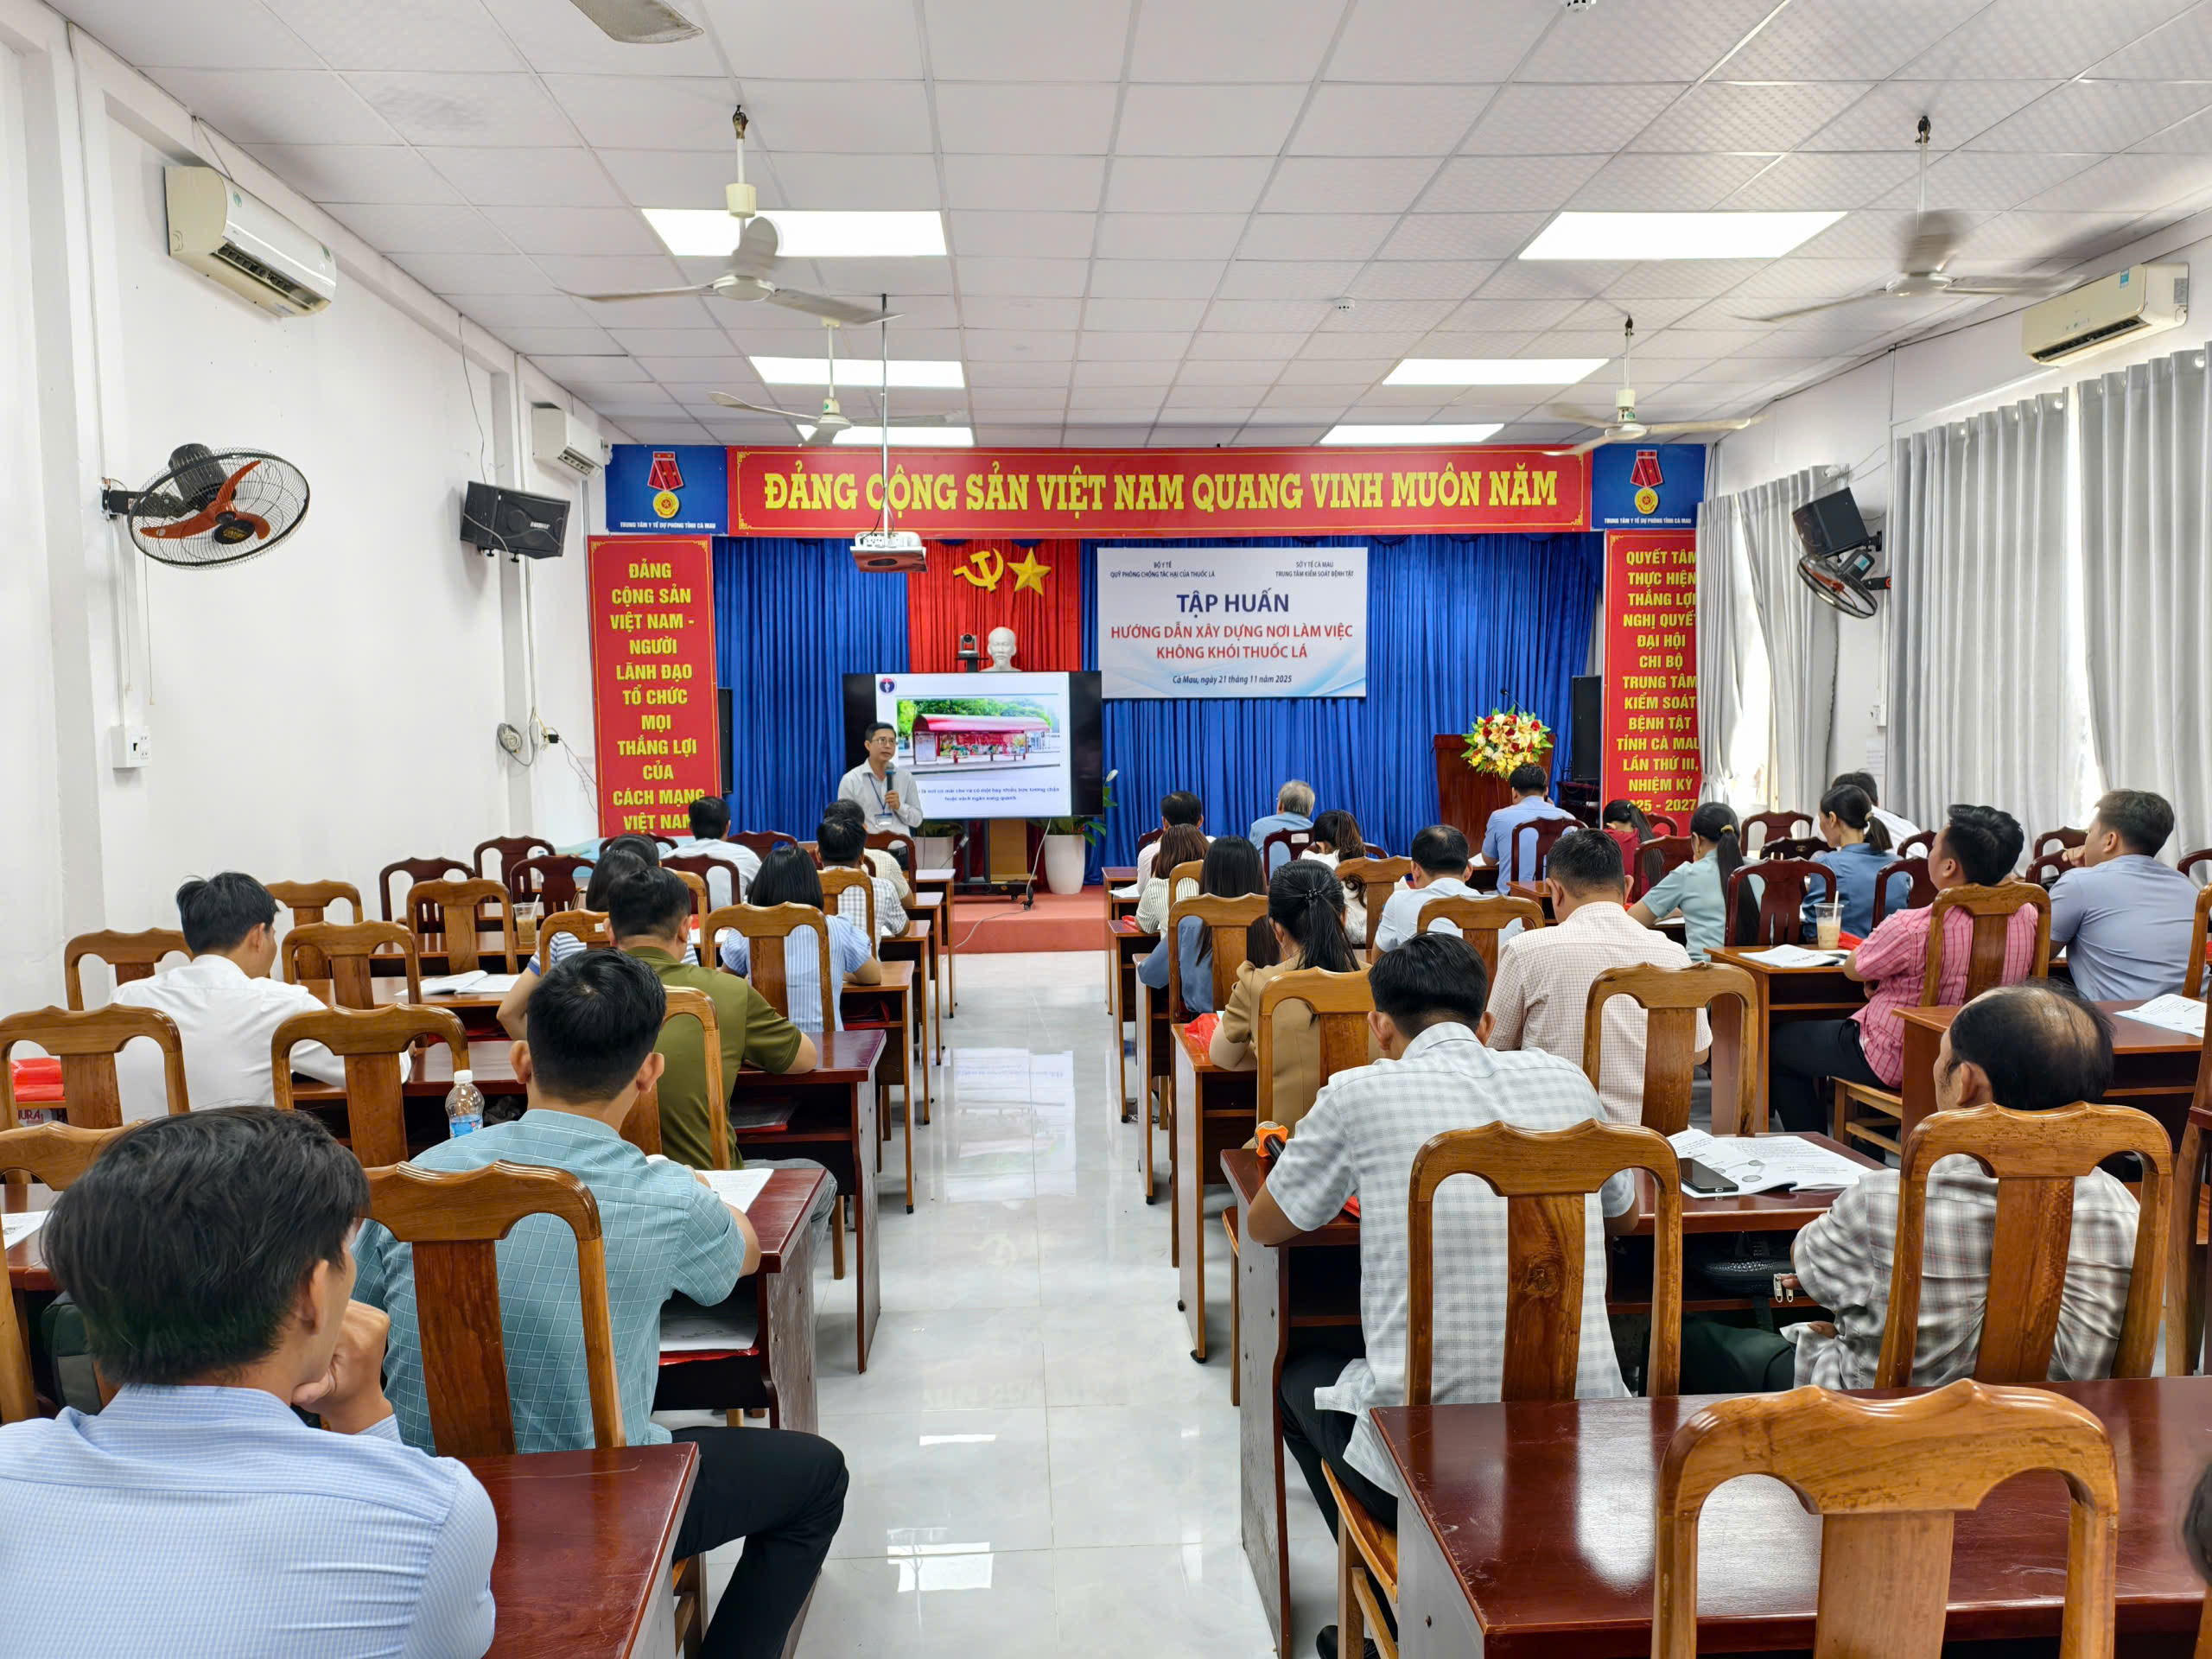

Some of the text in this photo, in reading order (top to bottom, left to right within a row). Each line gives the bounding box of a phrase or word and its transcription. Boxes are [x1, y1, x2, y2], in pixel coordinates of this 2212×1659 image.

[764, 460, 1557, 518] ĐẢNG CỘNG SẢN VIỆT NAM QUANG VINH MUÔN NĂM
[1626, 548, 1668, 565] QUYẾT
[629, 558, 671, 579] ĐẢNG
[1628, 569, 1696, 588] THỰC HIỆN
[611, 583, 691, 607] CỘNG SẢN
[1176, 588, 1288, 619] TẬP HUẤN
[1628, 588, 1672, 607] THẮNG
[610, 611, 643, 632] VIỆT
[647, 613, 683, 629] NAM
[1624, 610, 1696, 629] NGHỊ QUYẾ
[1111, 621, 1353, 641] HƯỚNG DẪN XÂY DỰNG NƠI LÀM VIỆC
[629, 636, 677, 655] NGƯỜI
[1157, 642, 1307, 658] KHÔNG KHÓI THUỐC LÁ
[1637, 632, 1686, 650] ĐẠI HỘI
[1639, 652, 1683, 671] CHI BỘ
[616, 662, 692, 683] LÃNH ĐẠO
[1173, 675, 1181, 683] Cà
[1182, 675, 1199, 684] Mau,
[1200, 675, 1217, 685] ngày
[1228, 675, 1249, 685] tháng
[1623, 676, 1666, 690] TRUNG
[622, 684, 688, 705] TỔ CHỨC
[1624, 692, 1696, 709] KIỂM SOÁT
[641, 715, 671, 733] MỌI
[1629, 715, 1691, 733] BỆNH TẬT
[617, 734, 697, 758] THẮNG LỢI
[1617, 734, 1647, 751] TỈNH
[643, 760, 674, 780] CỦA
[1654, 755, 1678, 771] THỨ
[1681, 759, 1699, 772] III,
[1629, 776, 1672, 793] NHIỆM
[613, 788, 654, 805] CÁCH
[1630, 799, 1652, 811] 25
[1665, 798, 1697, 811] 2027
[623, 812, 656, 834] VIỆT
